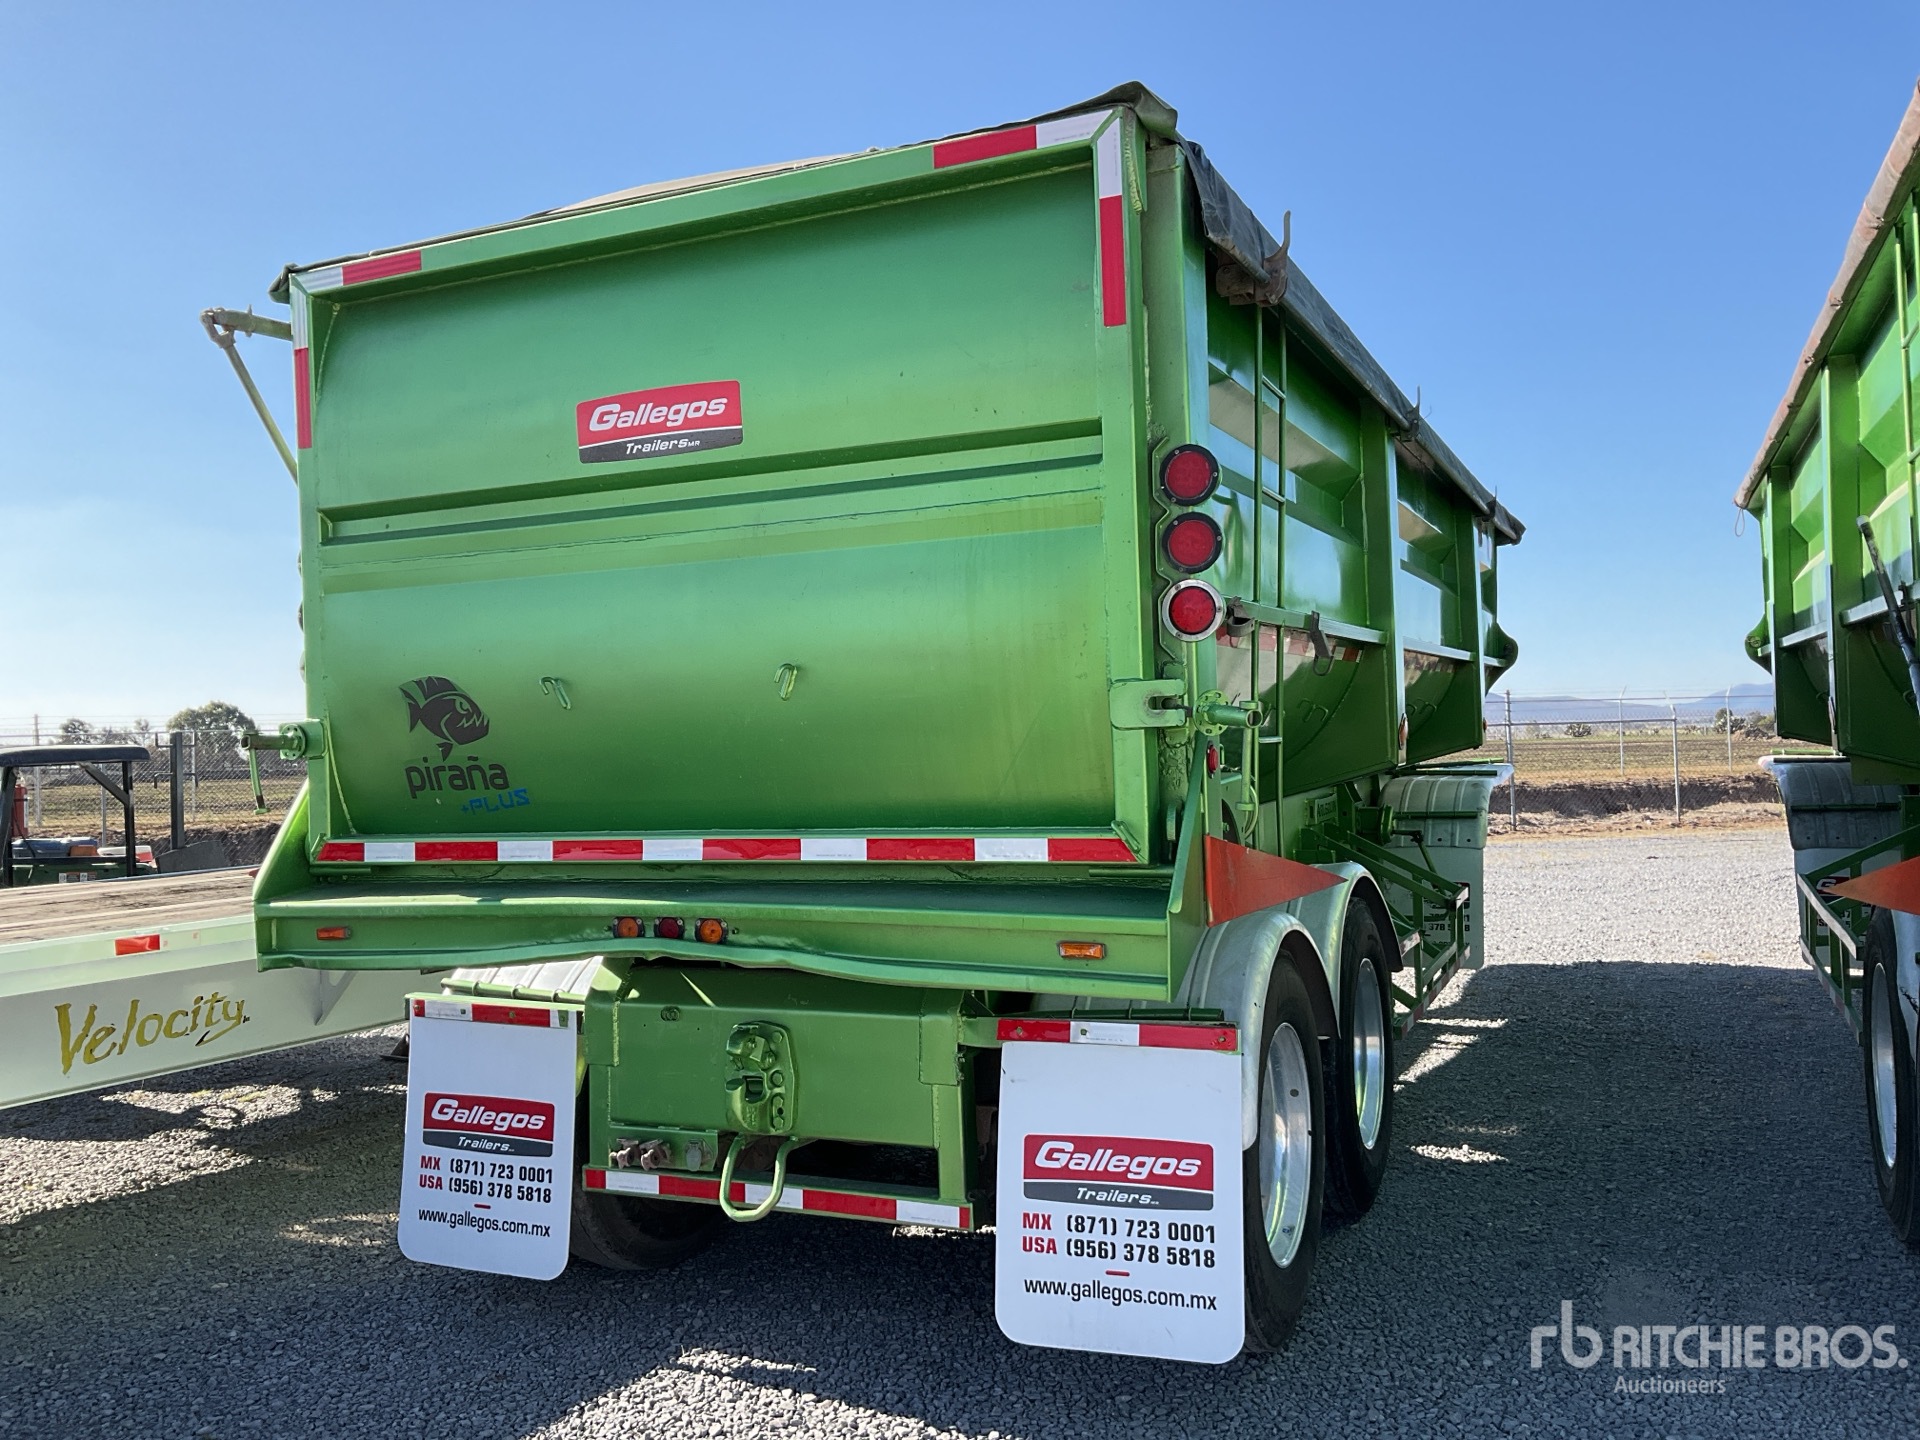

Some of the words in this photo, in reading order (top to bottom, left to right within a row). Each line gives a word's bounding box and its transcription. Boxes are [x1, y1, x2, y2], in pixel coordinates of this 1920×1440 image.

[589, 398, 728, 431] Gallegos
[626, 438, 688, 455] Trailers
[405, 755, 510, 799] piraña
[54, 992, 245, 1075] Velocity
[431, 1098, 546, 1131] Gallegos
[457, 1136, 510, 1151] Trailers
[420, 1155, 441, 1171] MX
[450, 1158, 485, 1176] (871)
[489, 1162, 514, 1180] 723
[519, 1166, 553, 1184] 0001
[1034, 1141, 1202, 1180] Gallegos
[419, 1174, 443, 1190] USA
[449, 1177, 483, 1196] (956)
[487, 1182, 512, 1199] 378
[517, 1186, 552, 1203] 5818
[1076, 1187, 1152, 1204] Trailers
[418, 1209, 551, 1237] www.gallegos.com.mx
[1022, 1212, 1052, 1231] MX
[1066, 1214, 1117, 1236] (871)
[1124, 1218, 1160, 1239] 723
[1167, 1222, 1215, 1244] 0001
[1022, 1236, 1058, 1255] USA
[1066, 1238, 1117, 1260] (956)
[1123, 1243, 1160, 1264] 378
[1166, 1246, 1216, 1268] 5818
[1024, 1279, 1218, 1311] www.gallegos.com.mx
